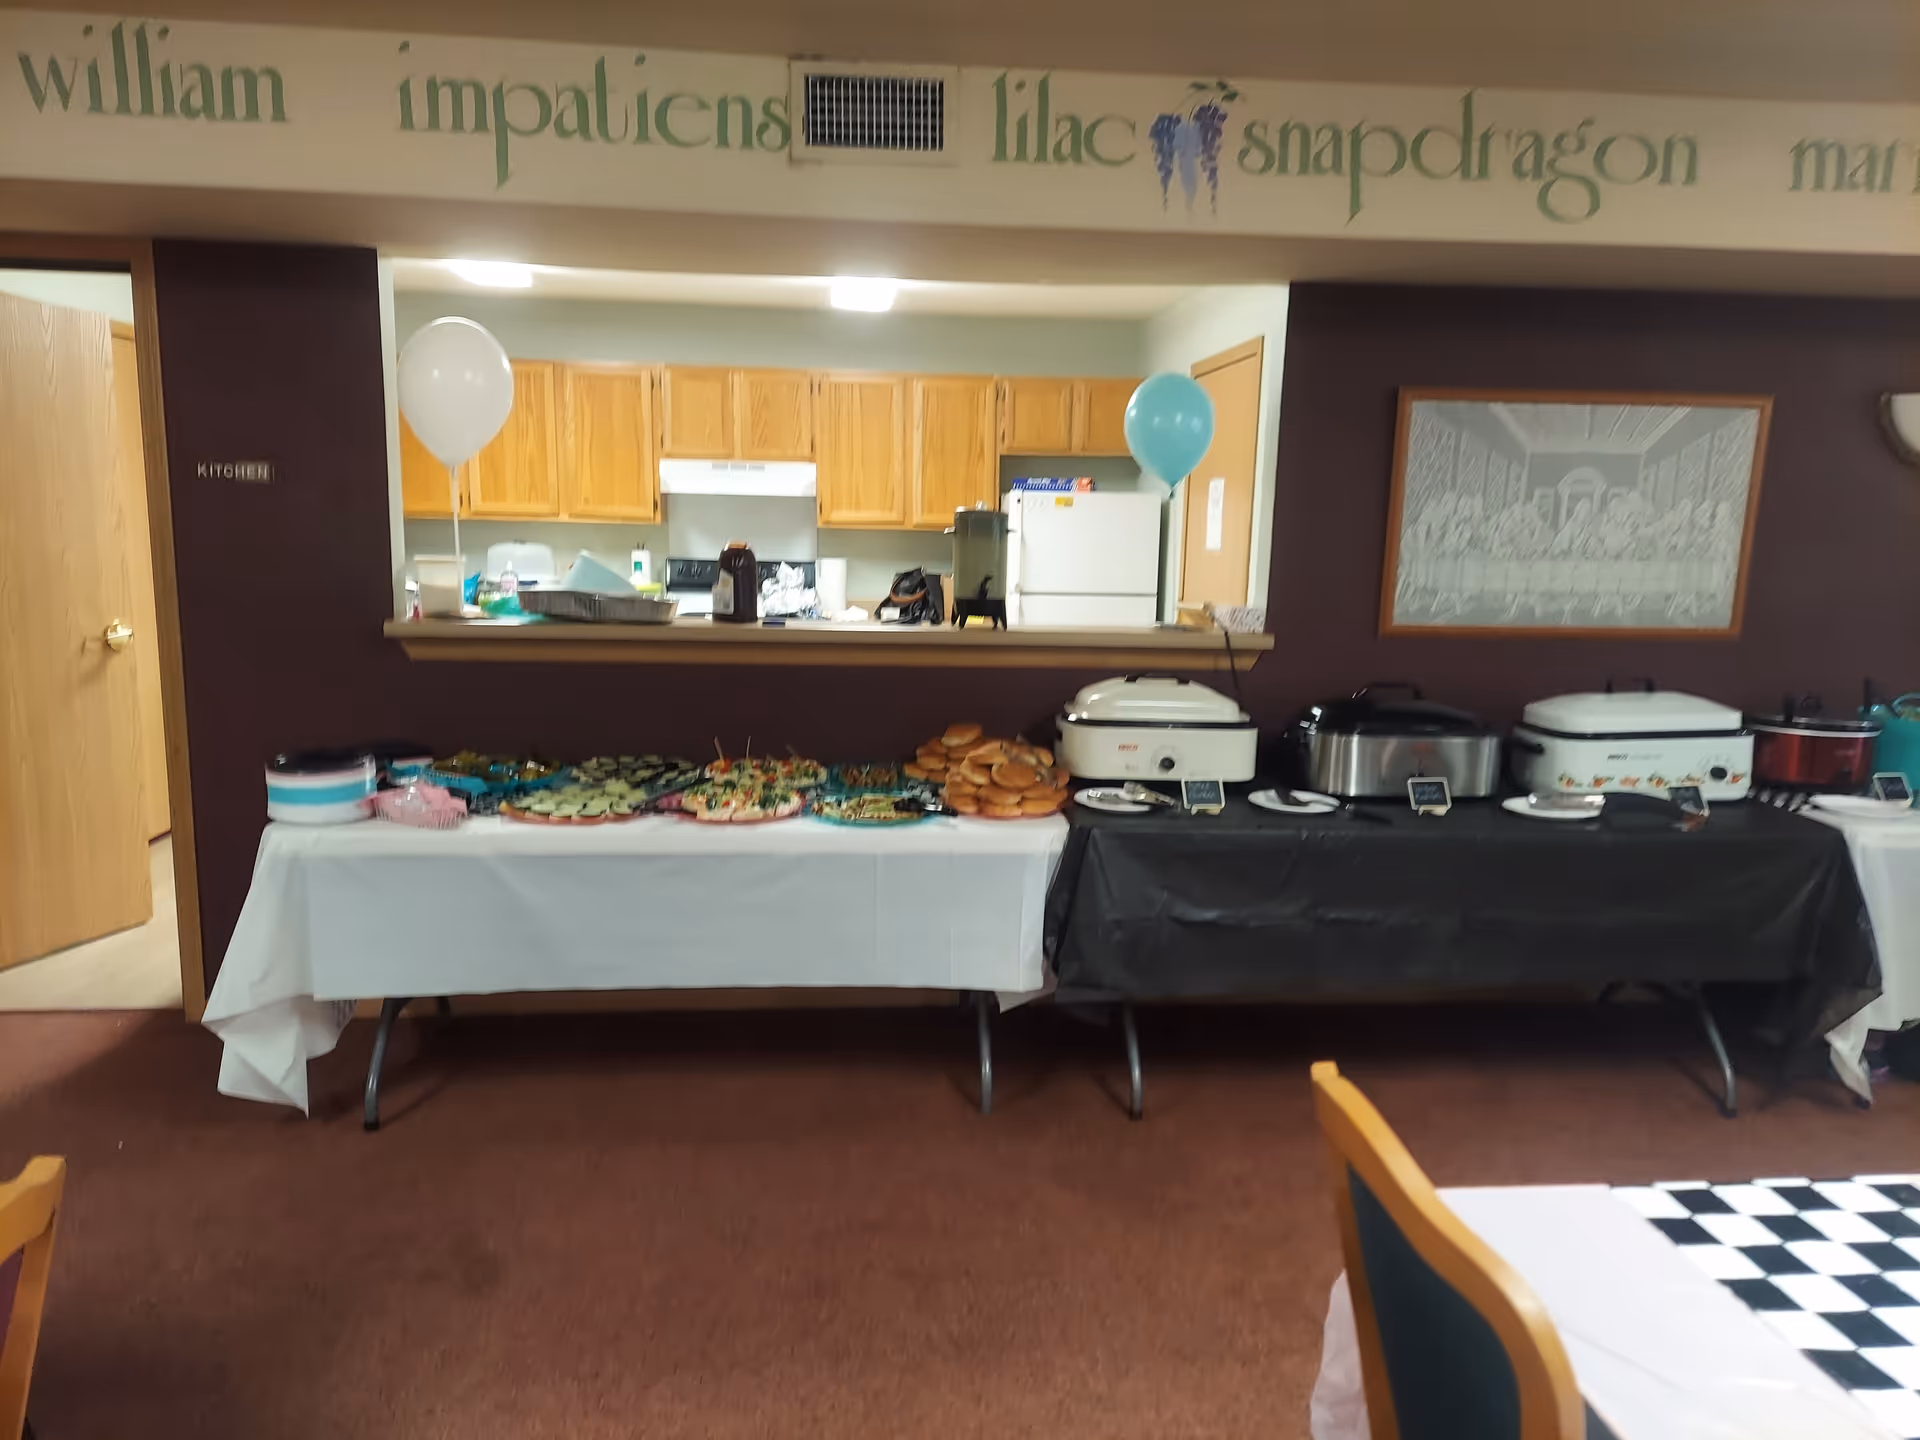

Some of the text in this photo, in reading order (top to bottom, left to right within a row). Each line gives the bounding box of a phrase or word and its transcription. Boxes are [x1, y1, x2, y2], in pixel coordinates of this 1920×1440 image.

[18, 20, 287, 122] william
[397, 41, 791, 190] impatiens
[991, 70, 1137, 167] lilac
[1237, 87, 1698, 225] snapdragon
[197, 461, 270, 481] KITCHEN
